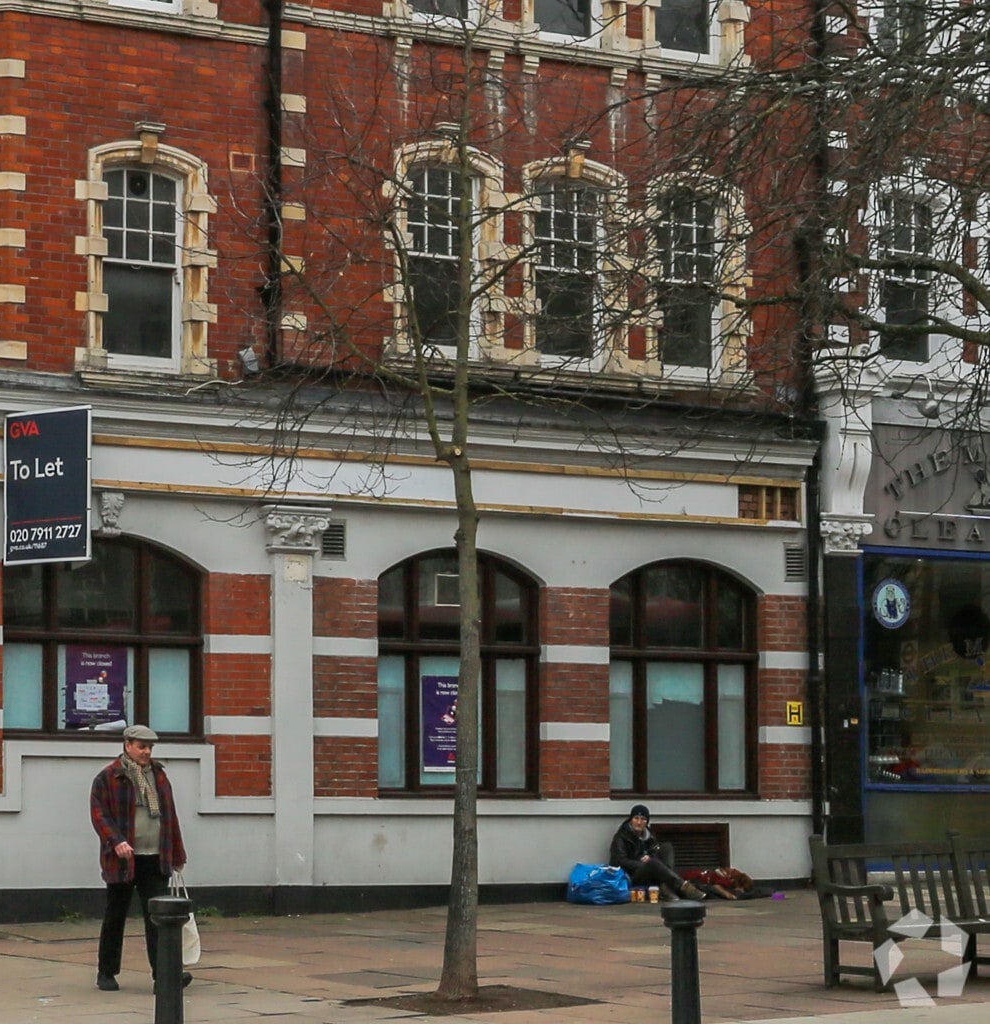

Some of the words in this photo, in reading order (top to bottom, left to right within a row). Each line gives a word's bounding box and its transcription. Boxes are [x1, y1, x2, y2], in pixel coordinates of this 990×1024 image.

[10, 421, 40, 438] GVA
[10, 460, 30, 480] To
[35, 457, 63, 478] Let
[884, 448, 951, 500] THE
[959, 441, 983, 464] M
[10, 528, 29, 542] 020
[31, 526, 53, 541] 7911
[55, 524, 82, 539] 2727
[884, 518, 984, 541] CLEA
[789, 704, 800, 722] H
